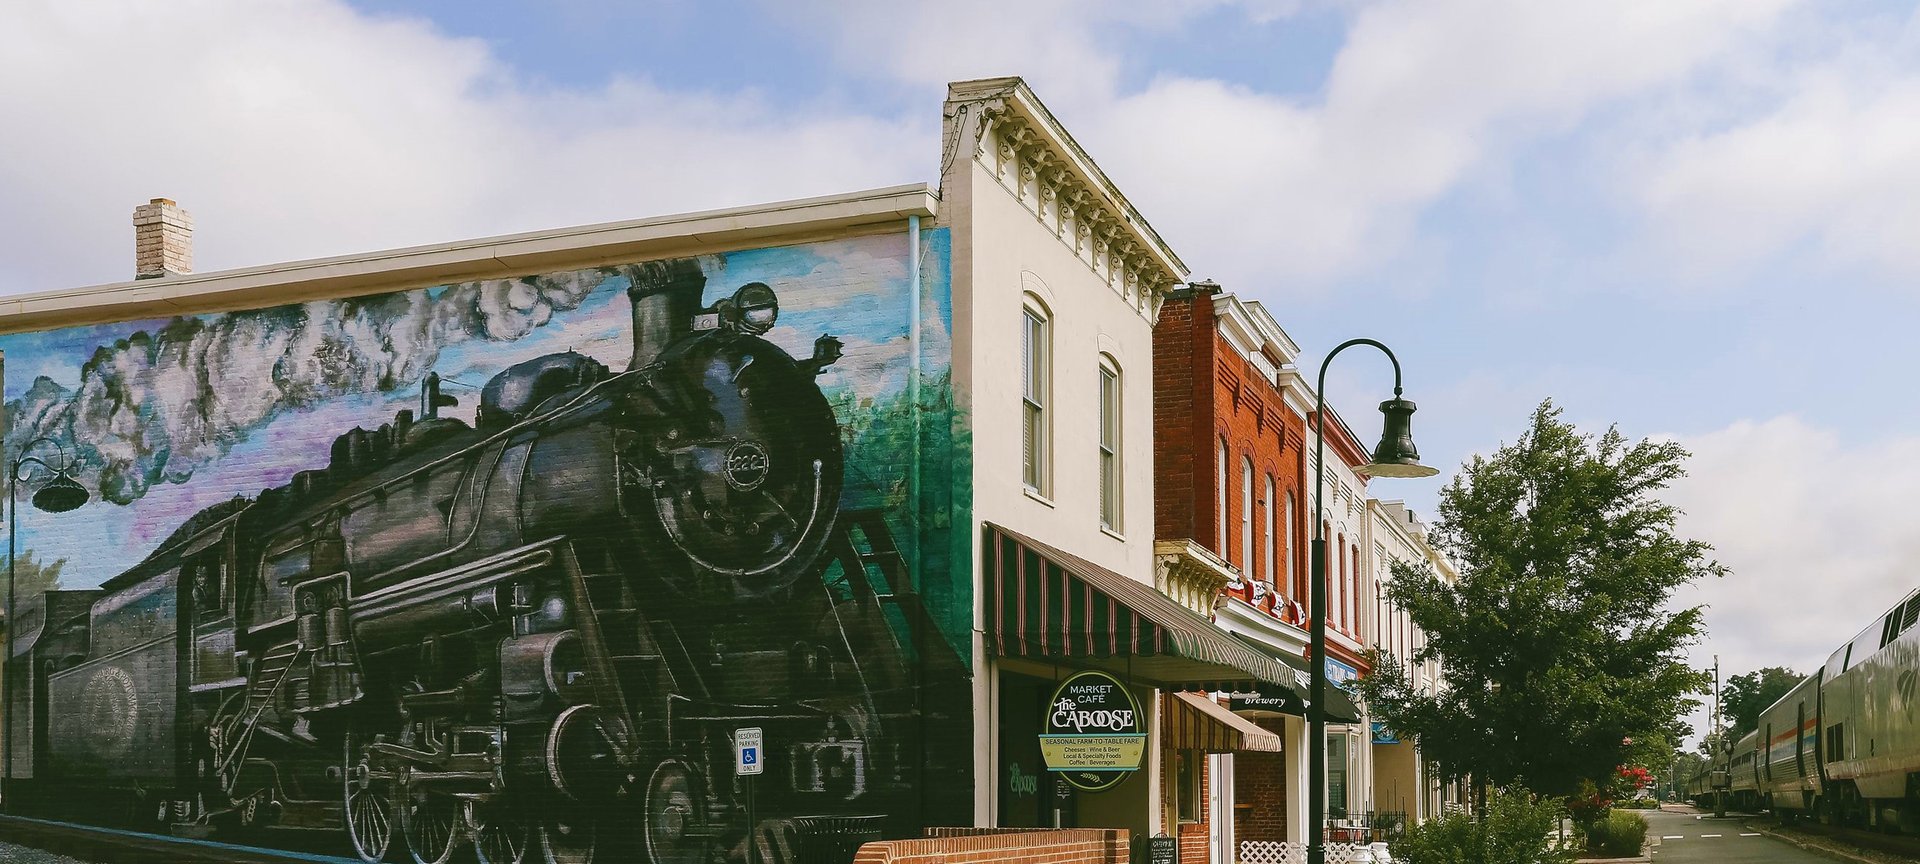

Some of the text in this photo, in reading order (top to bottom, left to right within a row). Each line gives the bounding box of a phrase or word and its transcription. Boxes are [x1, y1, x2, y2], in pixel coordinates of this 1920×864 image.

[734, 455, 758, 472] 222
[1070, 685, 1112, 693] MARKET
[1077, 694, 1105, 703] CAFÉ
[1244, 697, 1286, 707] brewery
[1052, 709, 1134, 733] CABOOSE
